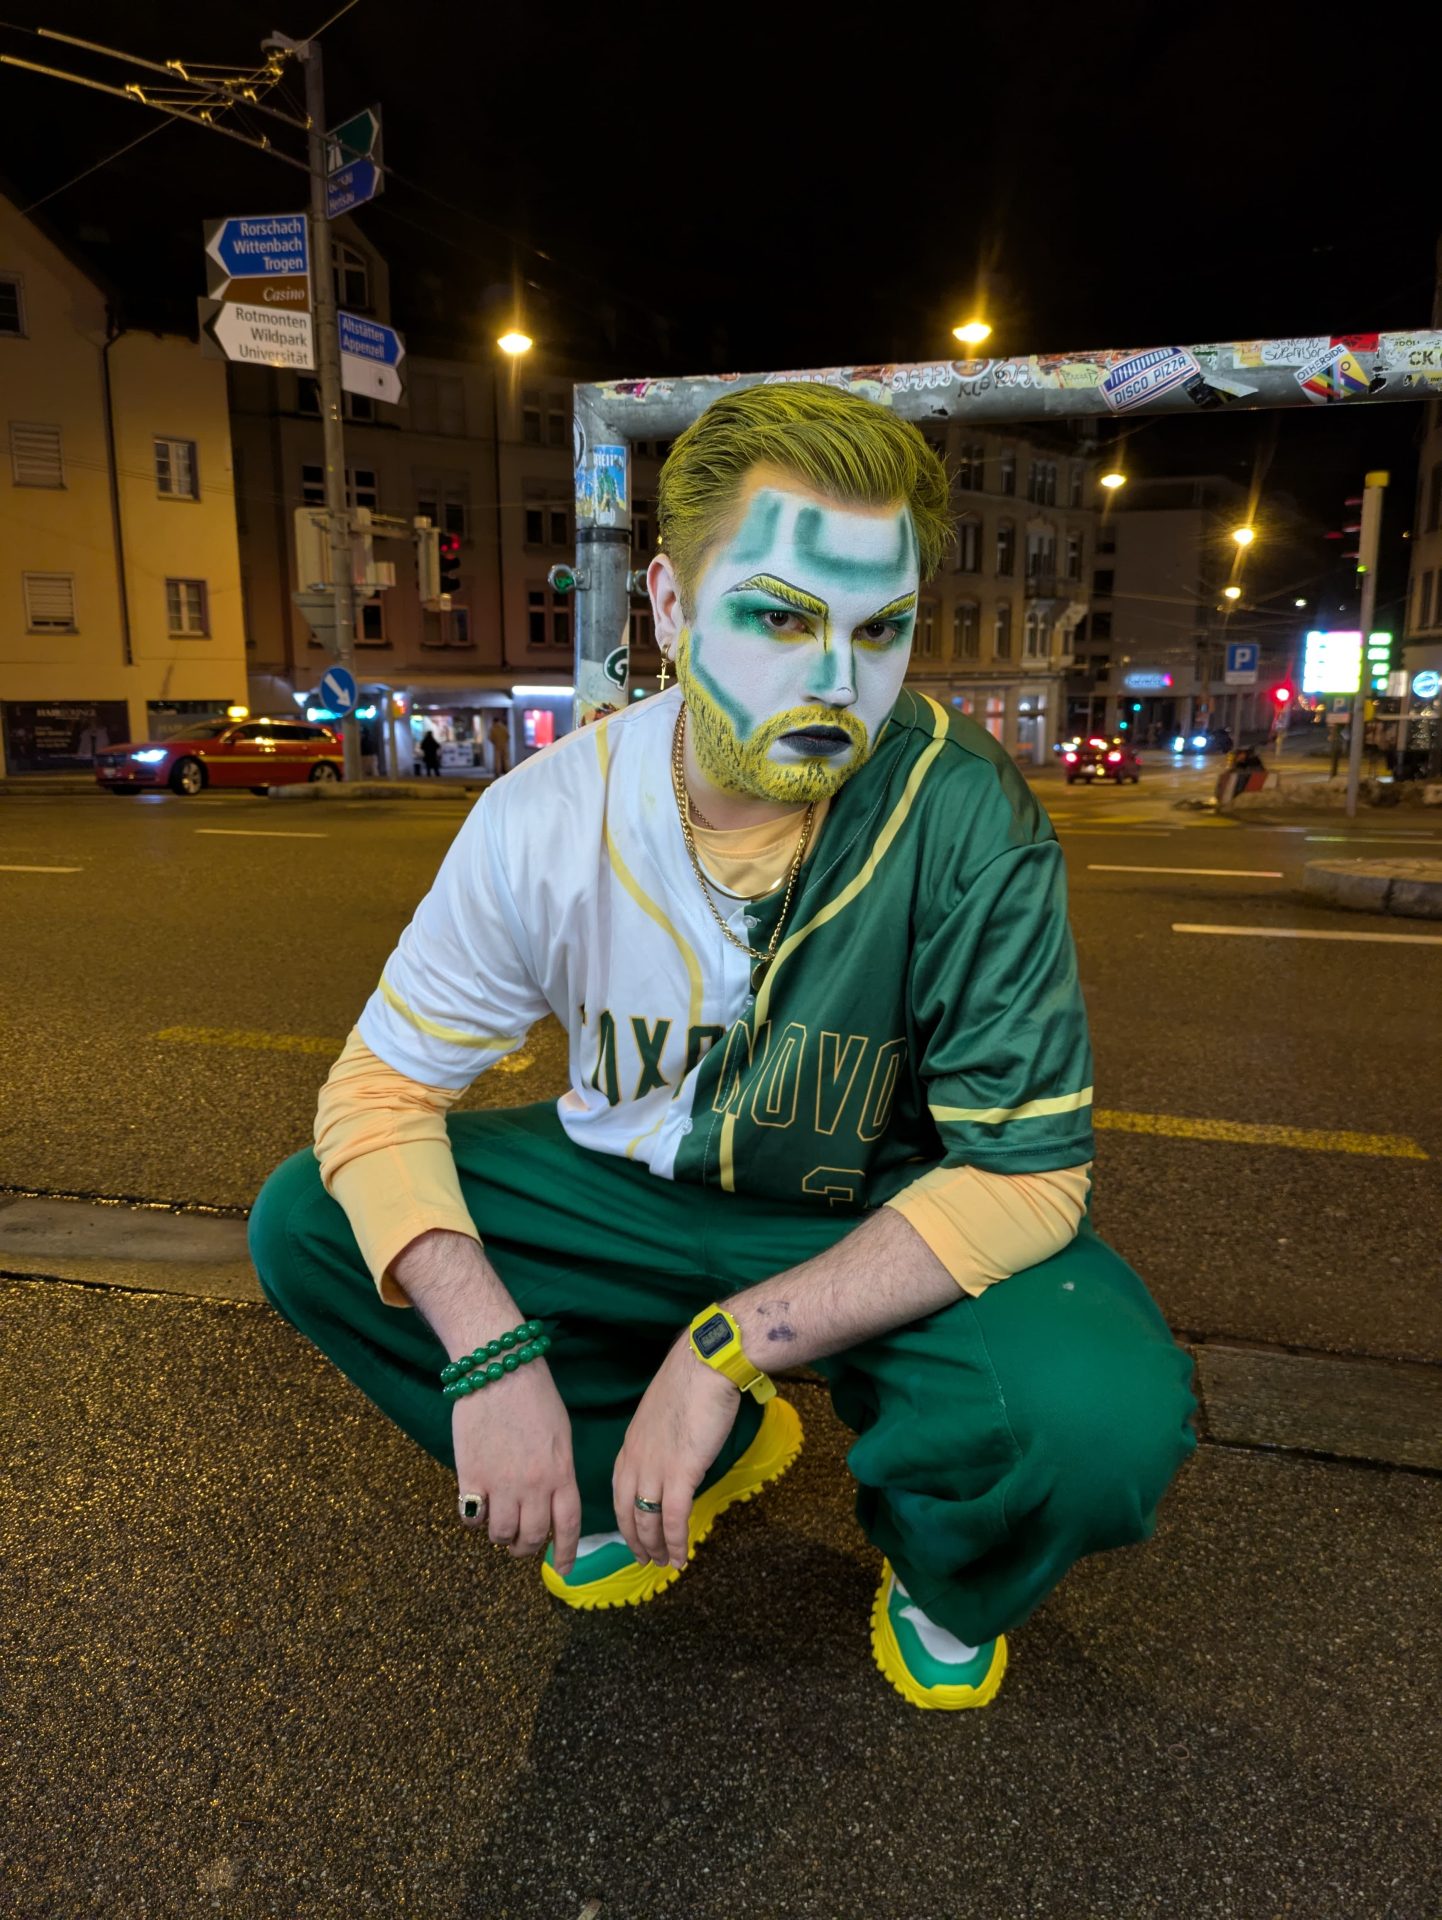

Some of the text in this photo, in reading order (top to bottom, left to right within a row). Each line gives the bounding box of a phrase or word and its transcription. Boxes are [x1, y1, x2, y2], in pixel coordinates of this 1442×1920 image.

[240, 219, 302, 237] Rorschach
[233, 237, 303, 255] Wittenbach
[263, 256, 304, 274] Trogen
[262, 286, 305, 302] Casino
[235, 307, 307, 329] Rotmonten
[250, 327, 307, 347] Wildpark
[342, 334, 385, 360] Appenzell
[238, 344, 309, 366] Universität
[1296, 345, 1346, 381] OTHERSIDE
[1114, 356, 1187, 405] DISCO PIZZA
[1234, 647, 1252, 669] P
